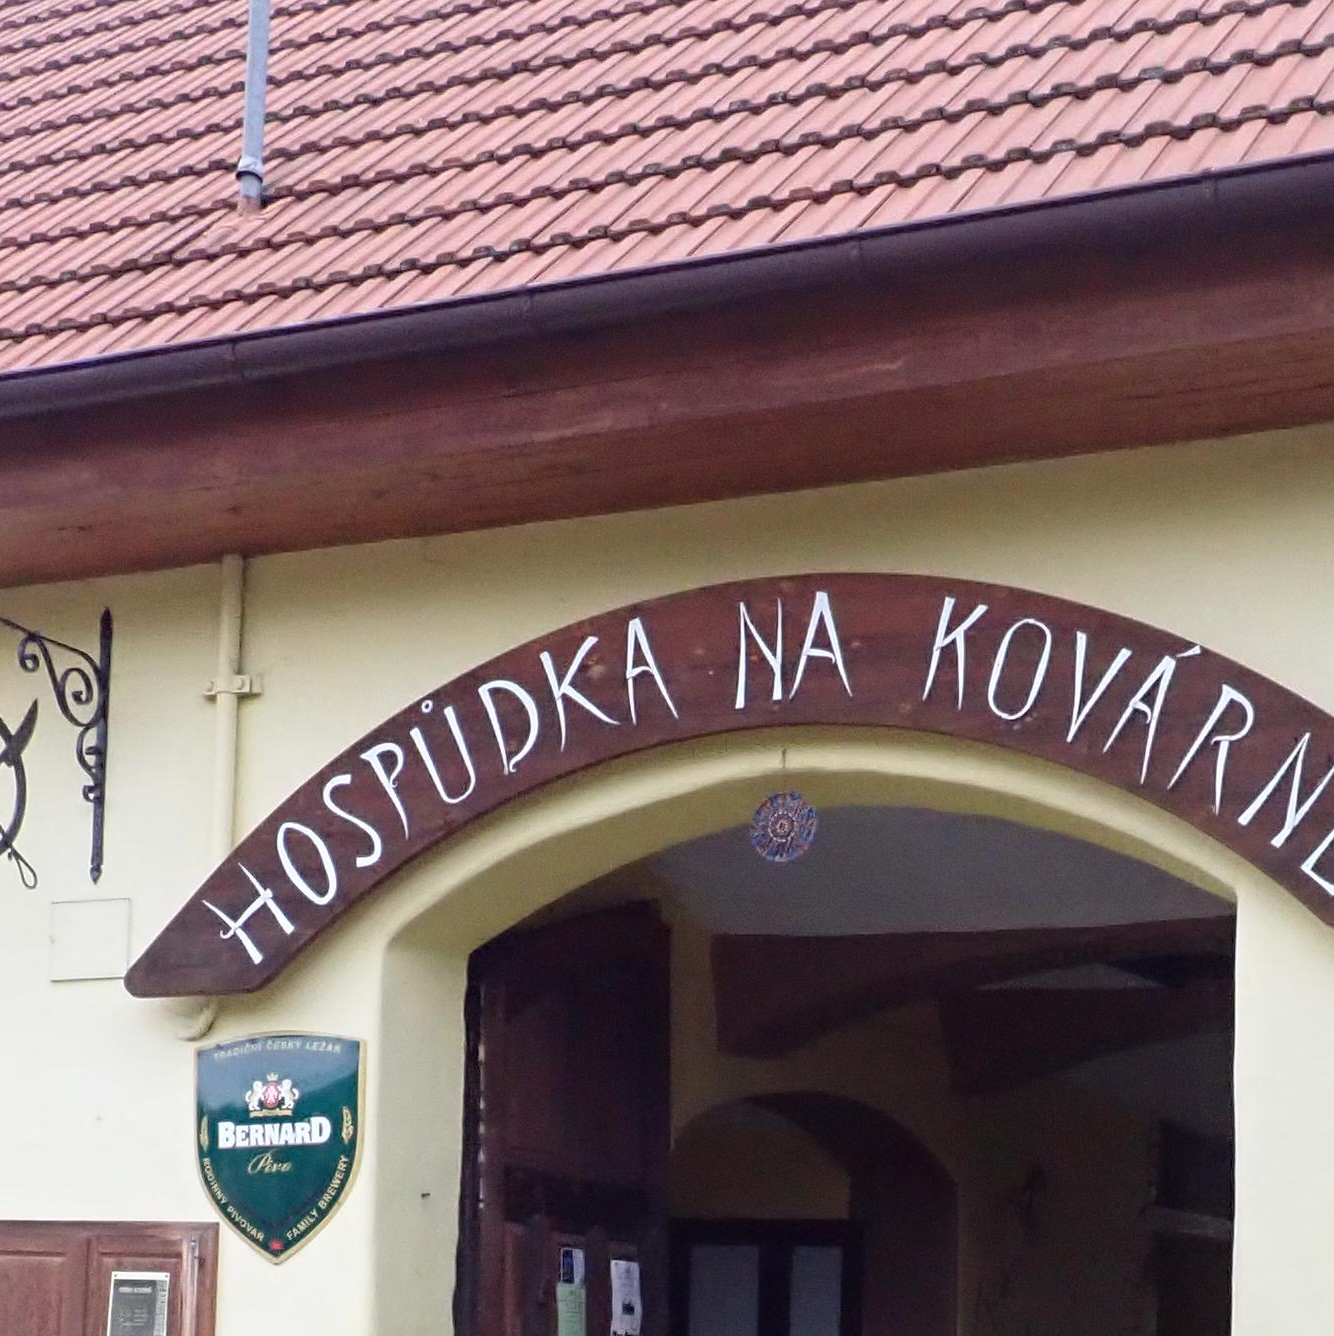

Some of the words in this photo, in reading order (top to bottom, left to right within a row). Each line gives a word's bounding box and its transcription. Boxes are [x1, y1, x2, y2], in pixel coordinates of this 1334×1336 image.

[202, 617, 678, 965] HOSPŮDKA
[734, 591, 853, 710] NA
[218, 1116, 332, 1149] BERNARD
[248, 1151, 292, 1174] Pivo
[287, 1208, 318, 1240] FAMILY
[318, 1155, 348, 1209] BREWERY
[227, 1205, 265, 1242] PIVOVAR
